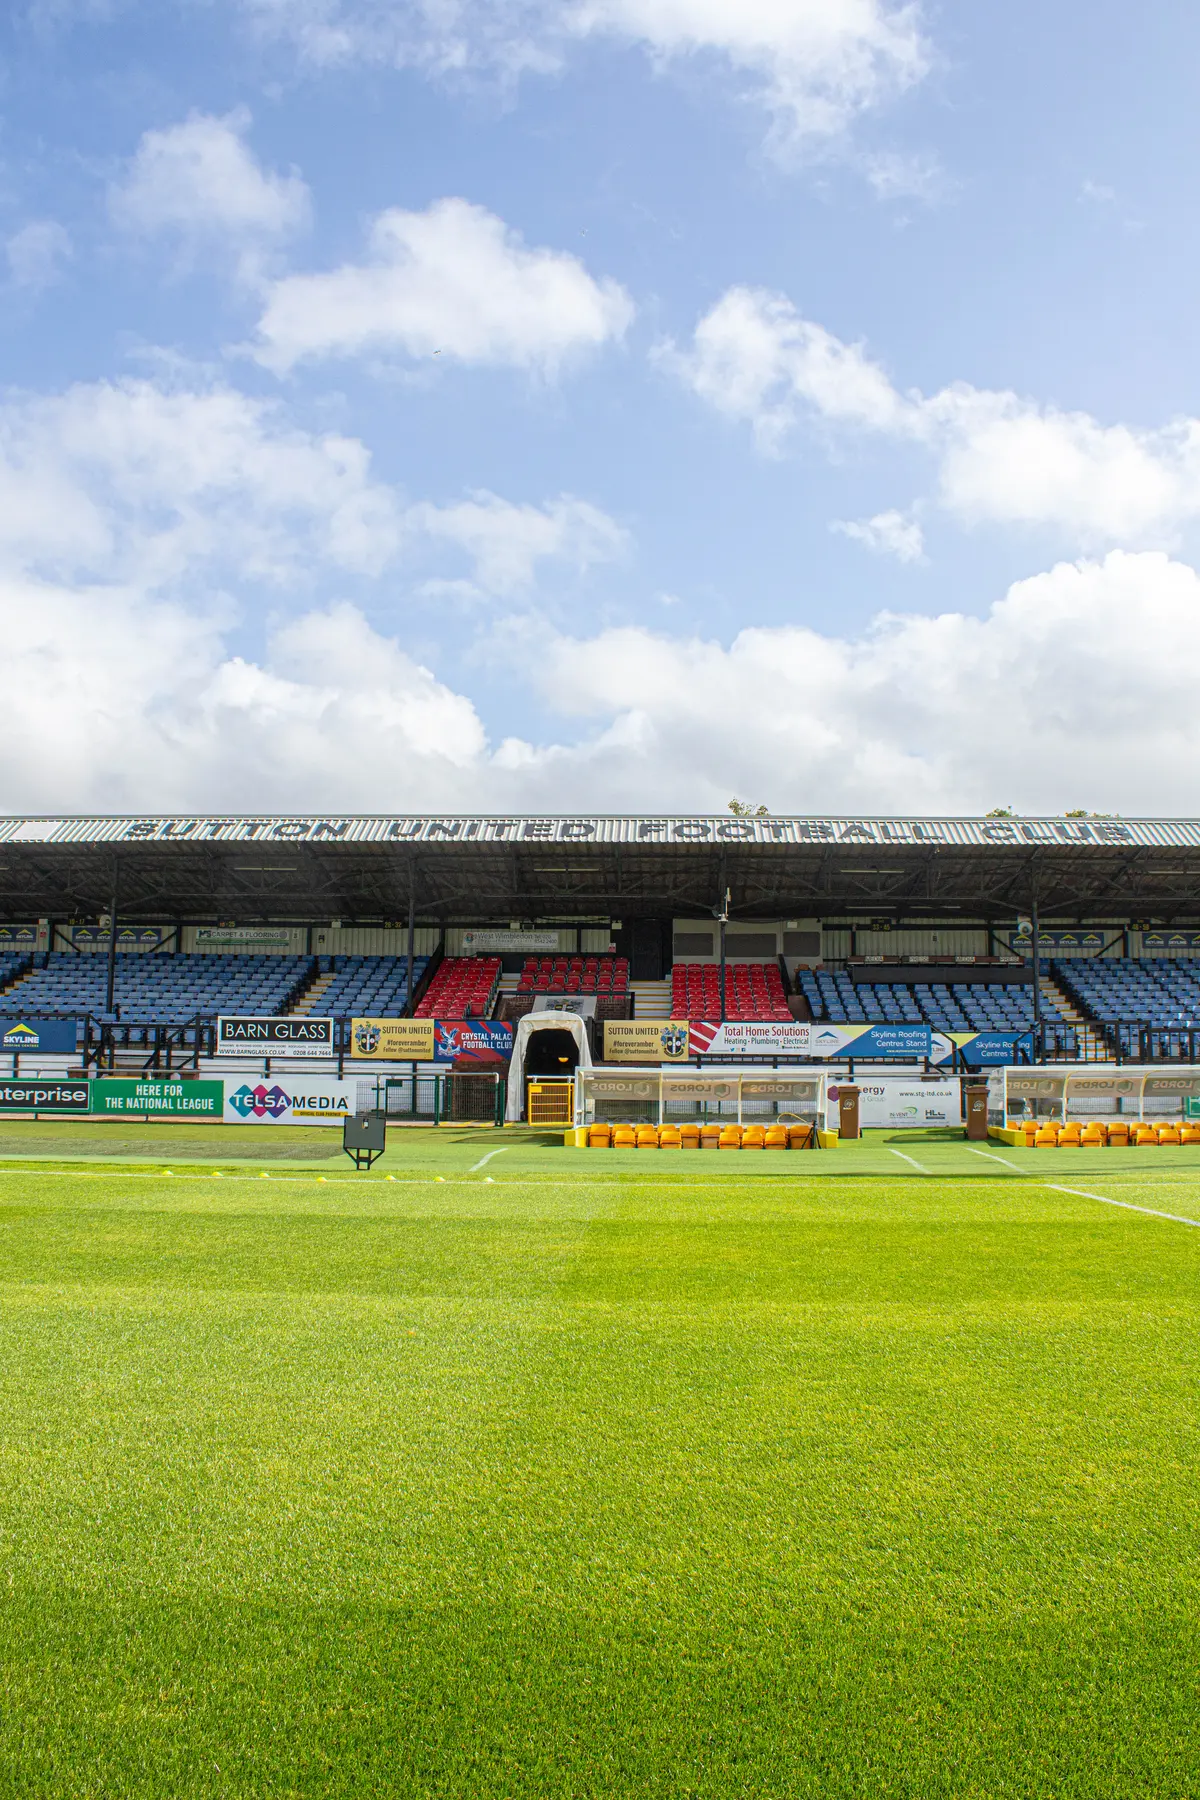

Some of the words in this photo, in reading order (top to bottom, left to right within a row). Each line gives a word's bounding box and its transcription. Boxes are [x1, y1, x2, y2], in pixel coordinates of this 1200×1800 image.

[125, 822, 350, 838] SUTTON
[388, 822, 595, 838] UNITED
[638, 822, 944, 840] FOOTBALL
[981, 825, 1132, 841] CLUB
[495, 932, 533, 940] Wimbledon
[225, 1023, 268, 1037] BARN
[274, 1023, 326, 1039] GLASS
[382, 1026, 407, 1034] SUTTON
[408, 1026, 432, 1035] UNITED
[608, 1027, 633, 1035] SUTTON
[635, 1027, 659, 1035] UNITED
[724, 1026, 744, 1036] Total
[746, 1026, 770, 1036] Home
[771, 1026, 809, 1036] Solutions
[870, 1031, 896, 1039] Skyline
[898, 1031, 927, 1039] Roofing
[491, 1033, 513, 1041] PALAC
[387, 1039, 427, 1047] #foreveramber
[463, 1041, 494, 1049] FOOTBALL
[724, 1038, 748, 1046] Heating
[751, 1038, 779, 1046] Plumbing
[975, 1041, 1001, 1049] Skyline
[136, 1084, 161, 1096] HERE
[164, 1084, 183, 1096] FOR
[861, 1086, 886, 1096] ergy
[899, 1090, 952, 1098] www.stg-ltd.co.uk
[0, 1087, 86, 1105] terprise
[105, 1097, 123, 1108] THE
[126, 1098, 174, 1109] NATIONAL
[177, 1098, 214, 1110] LEAGUE
[233, 1094, 289, 1108] TELSA
[292, 1096, 349, 1109] MEDIA
